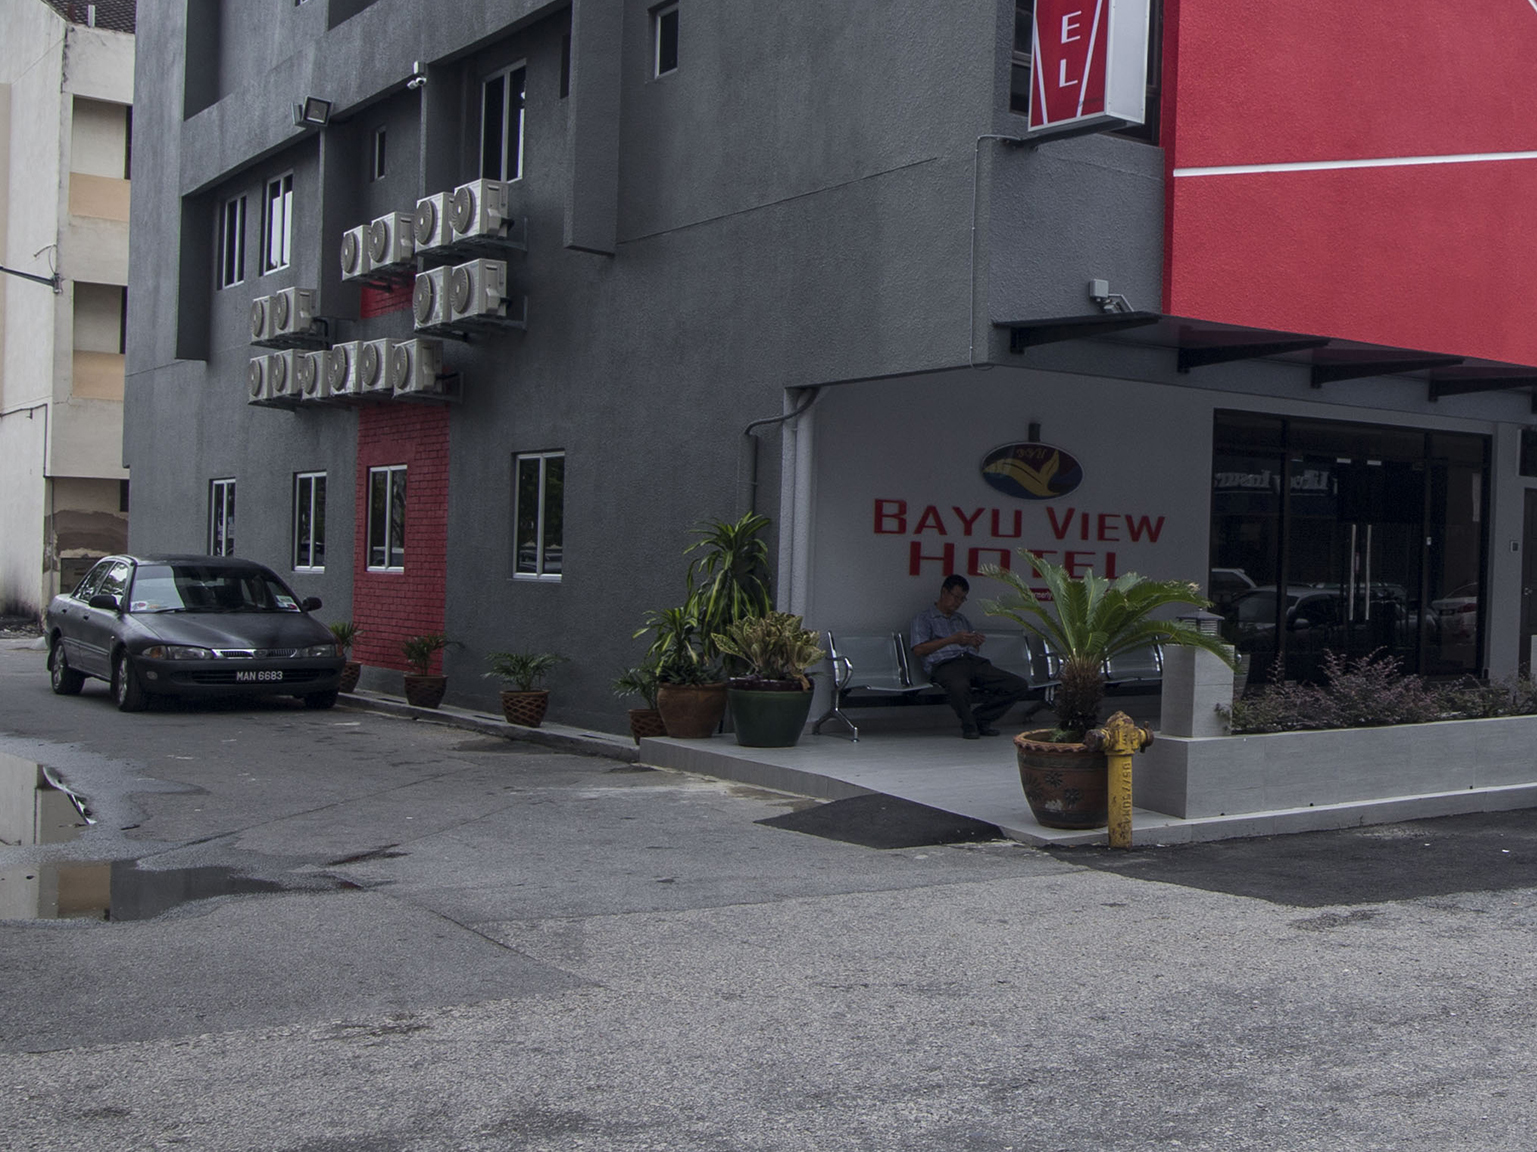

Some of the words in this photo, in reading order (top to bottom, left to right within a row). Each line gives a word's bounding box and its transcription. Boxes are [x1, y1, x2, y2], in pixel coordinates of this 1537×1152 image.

[873, 498, 1022, 538] BAYU
[1046, 506, 1165, 544] VIEW
[908, 541, 1119, 581] HOTEL
[236, 671, 257, 681] MAN
[258, 671, 283, 681] 6683
